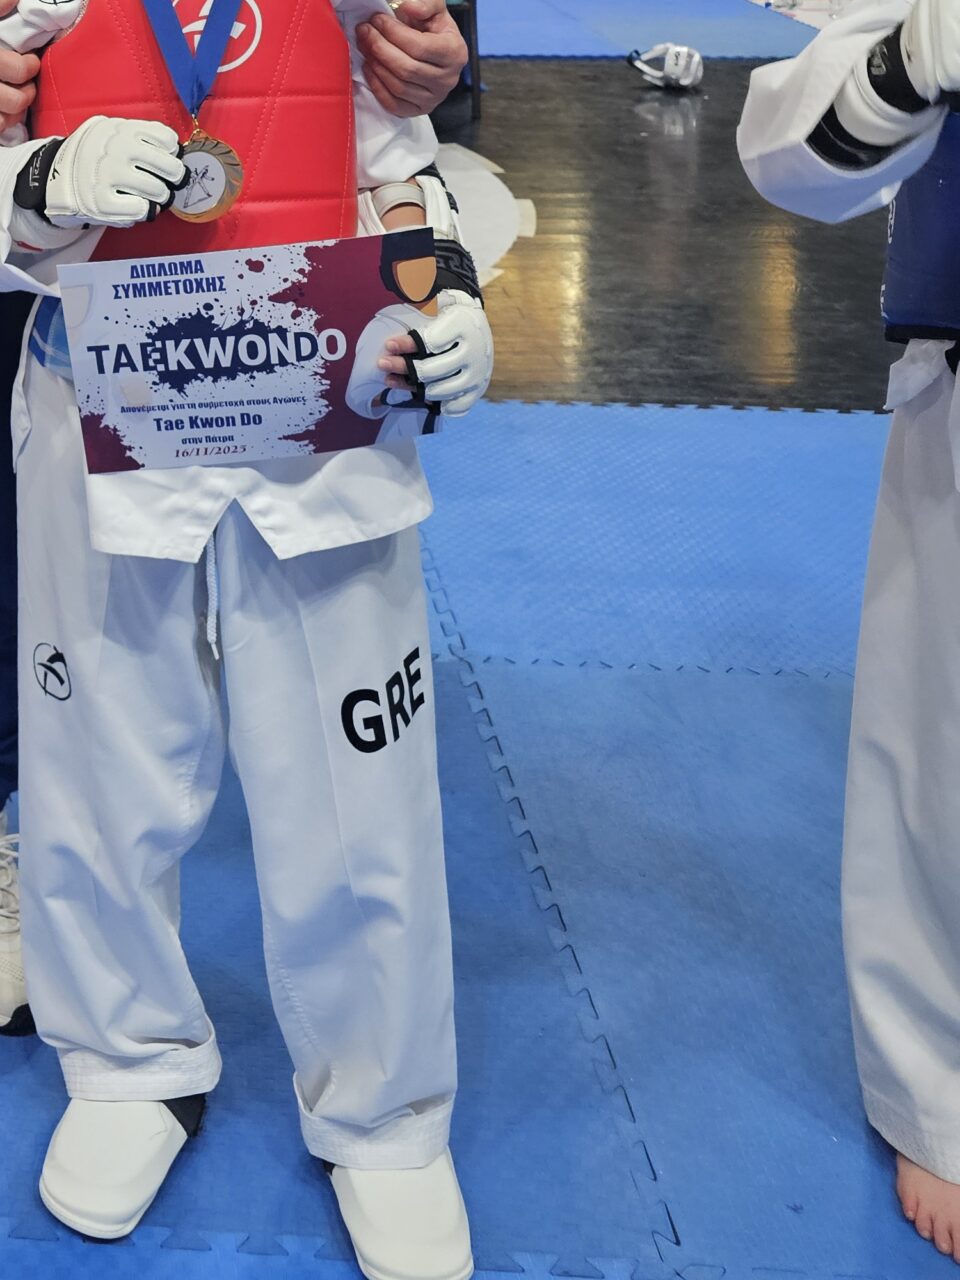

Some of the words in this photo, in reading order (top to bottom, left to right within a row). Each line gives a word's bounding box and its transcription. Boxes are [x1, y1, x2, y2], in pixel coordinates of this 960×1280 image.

[130, 259, 205, 279] ΔΙΠΛΩΜΑ
[112, 275, 227, 300] ΣΥΜΜΕΤΟΧΗΣ
[87, 328, 347, 375] TAEKWONDO
[246, 398, 271, 407] στους
[153, 417, 185, 432] Tae
[188, 414, 236, 430] Kwon
[240, 412, 263, 426] Do
[181, 436, 203, 446] στην
[204, 434, 235, 445] Πάτρα
[174, 444, 247, 458] 16/11/2025
[340, 646, 425, 753] GRE
